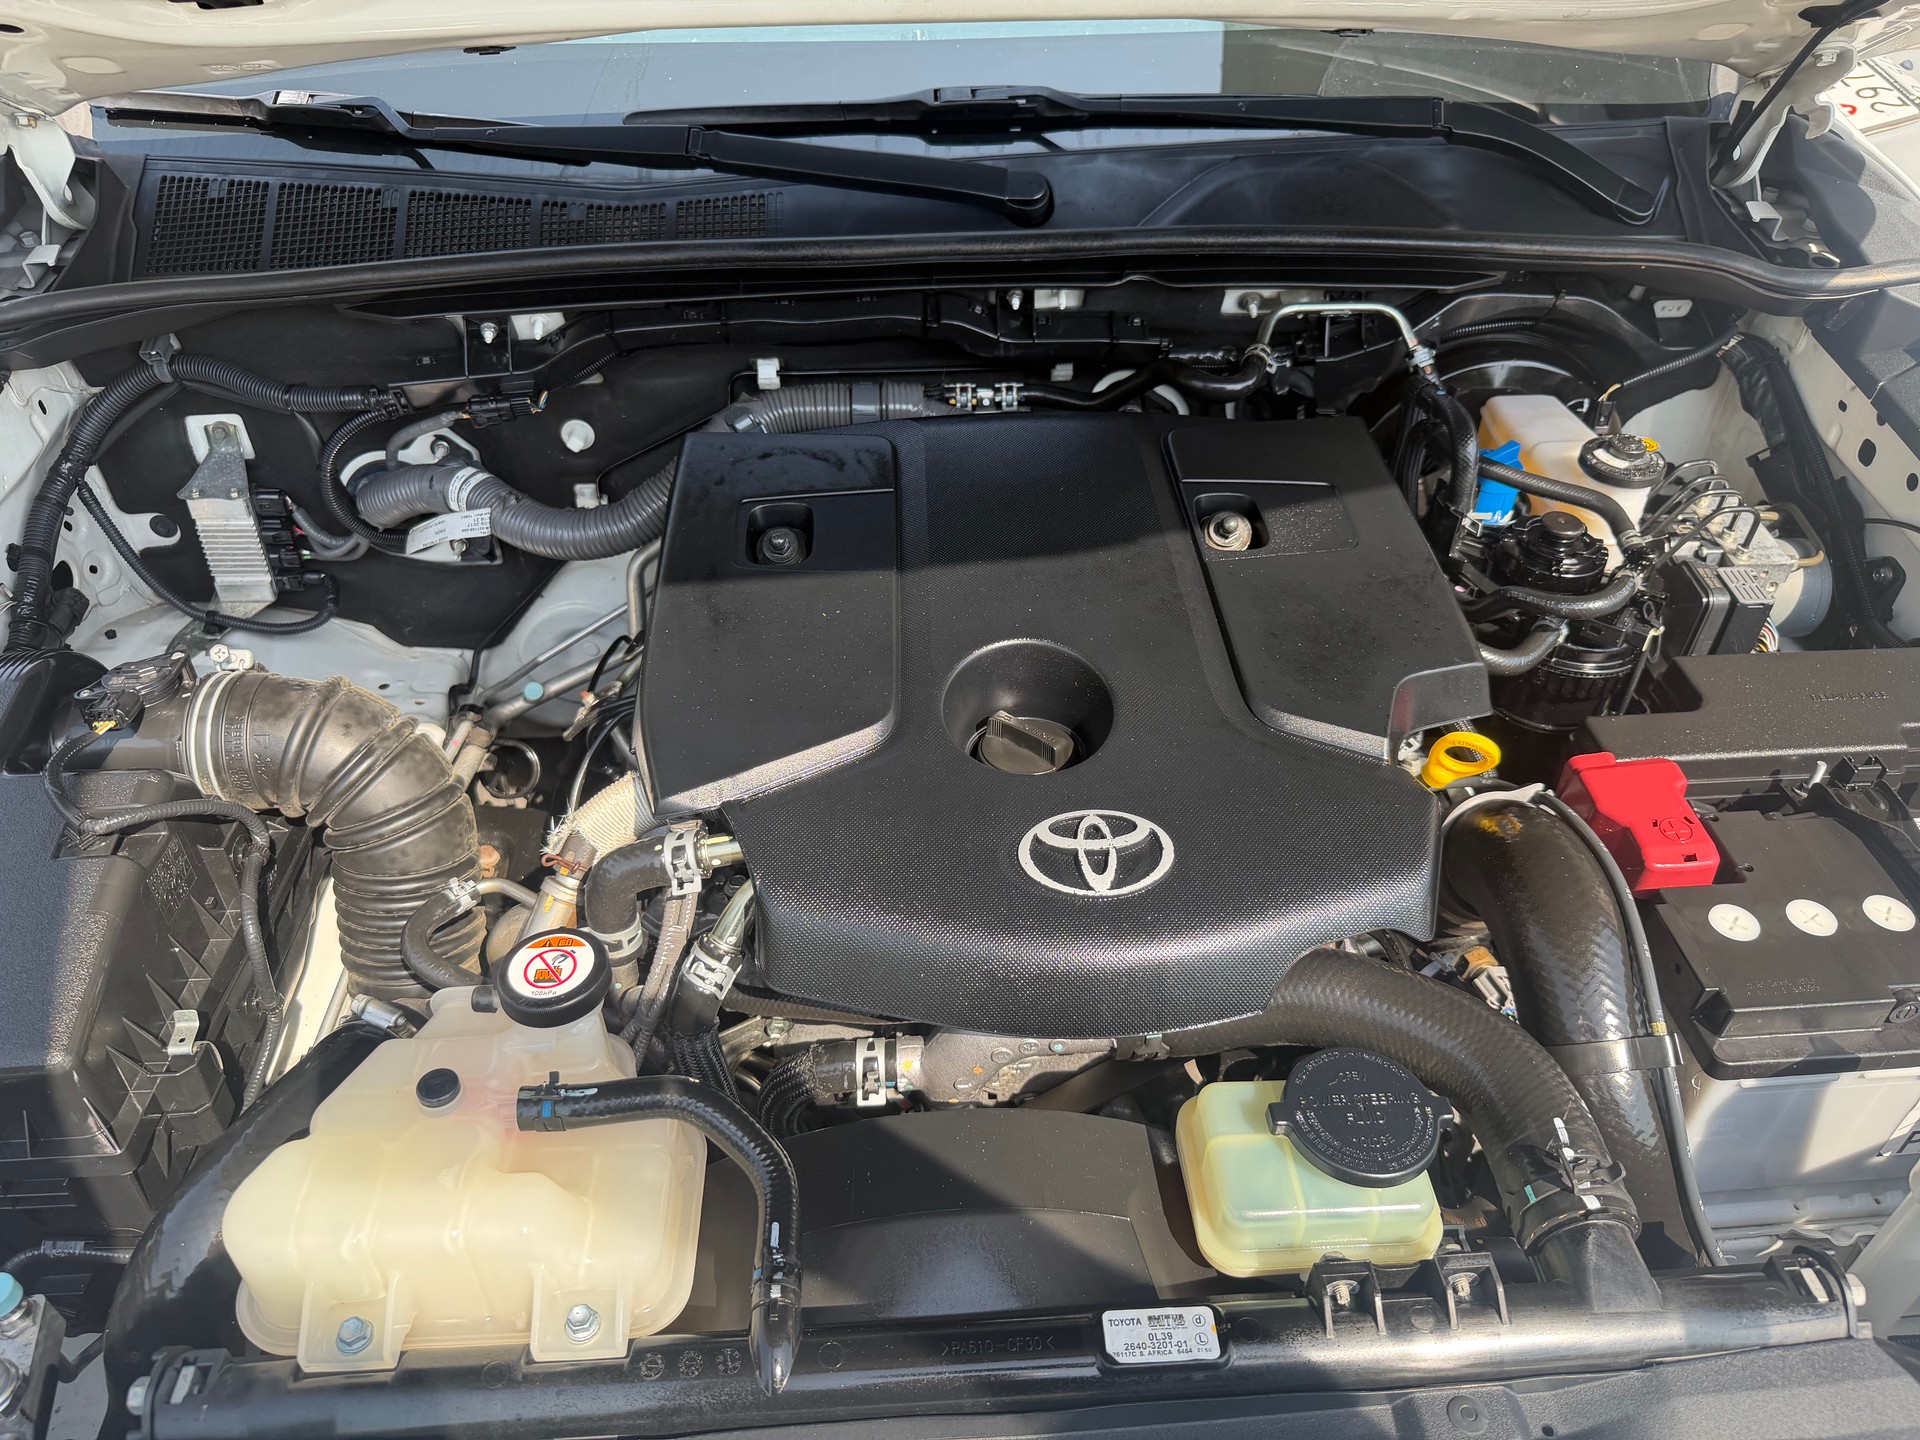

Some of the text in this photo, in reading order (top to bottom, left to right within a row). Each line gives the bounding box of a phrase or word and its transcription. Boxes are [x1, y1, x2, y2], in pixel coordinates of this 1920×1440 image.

[1300, 1092, 1421, 1108] POWER STEERING
[1347, 1112, 1387, 1125] FLUID
[1108, 1318, 1142, 1327] TOYOTA
[1148, 1332, 1173, 1341] 0L39
[1124, 1340, 1188, 1351] 2640-3201-01
